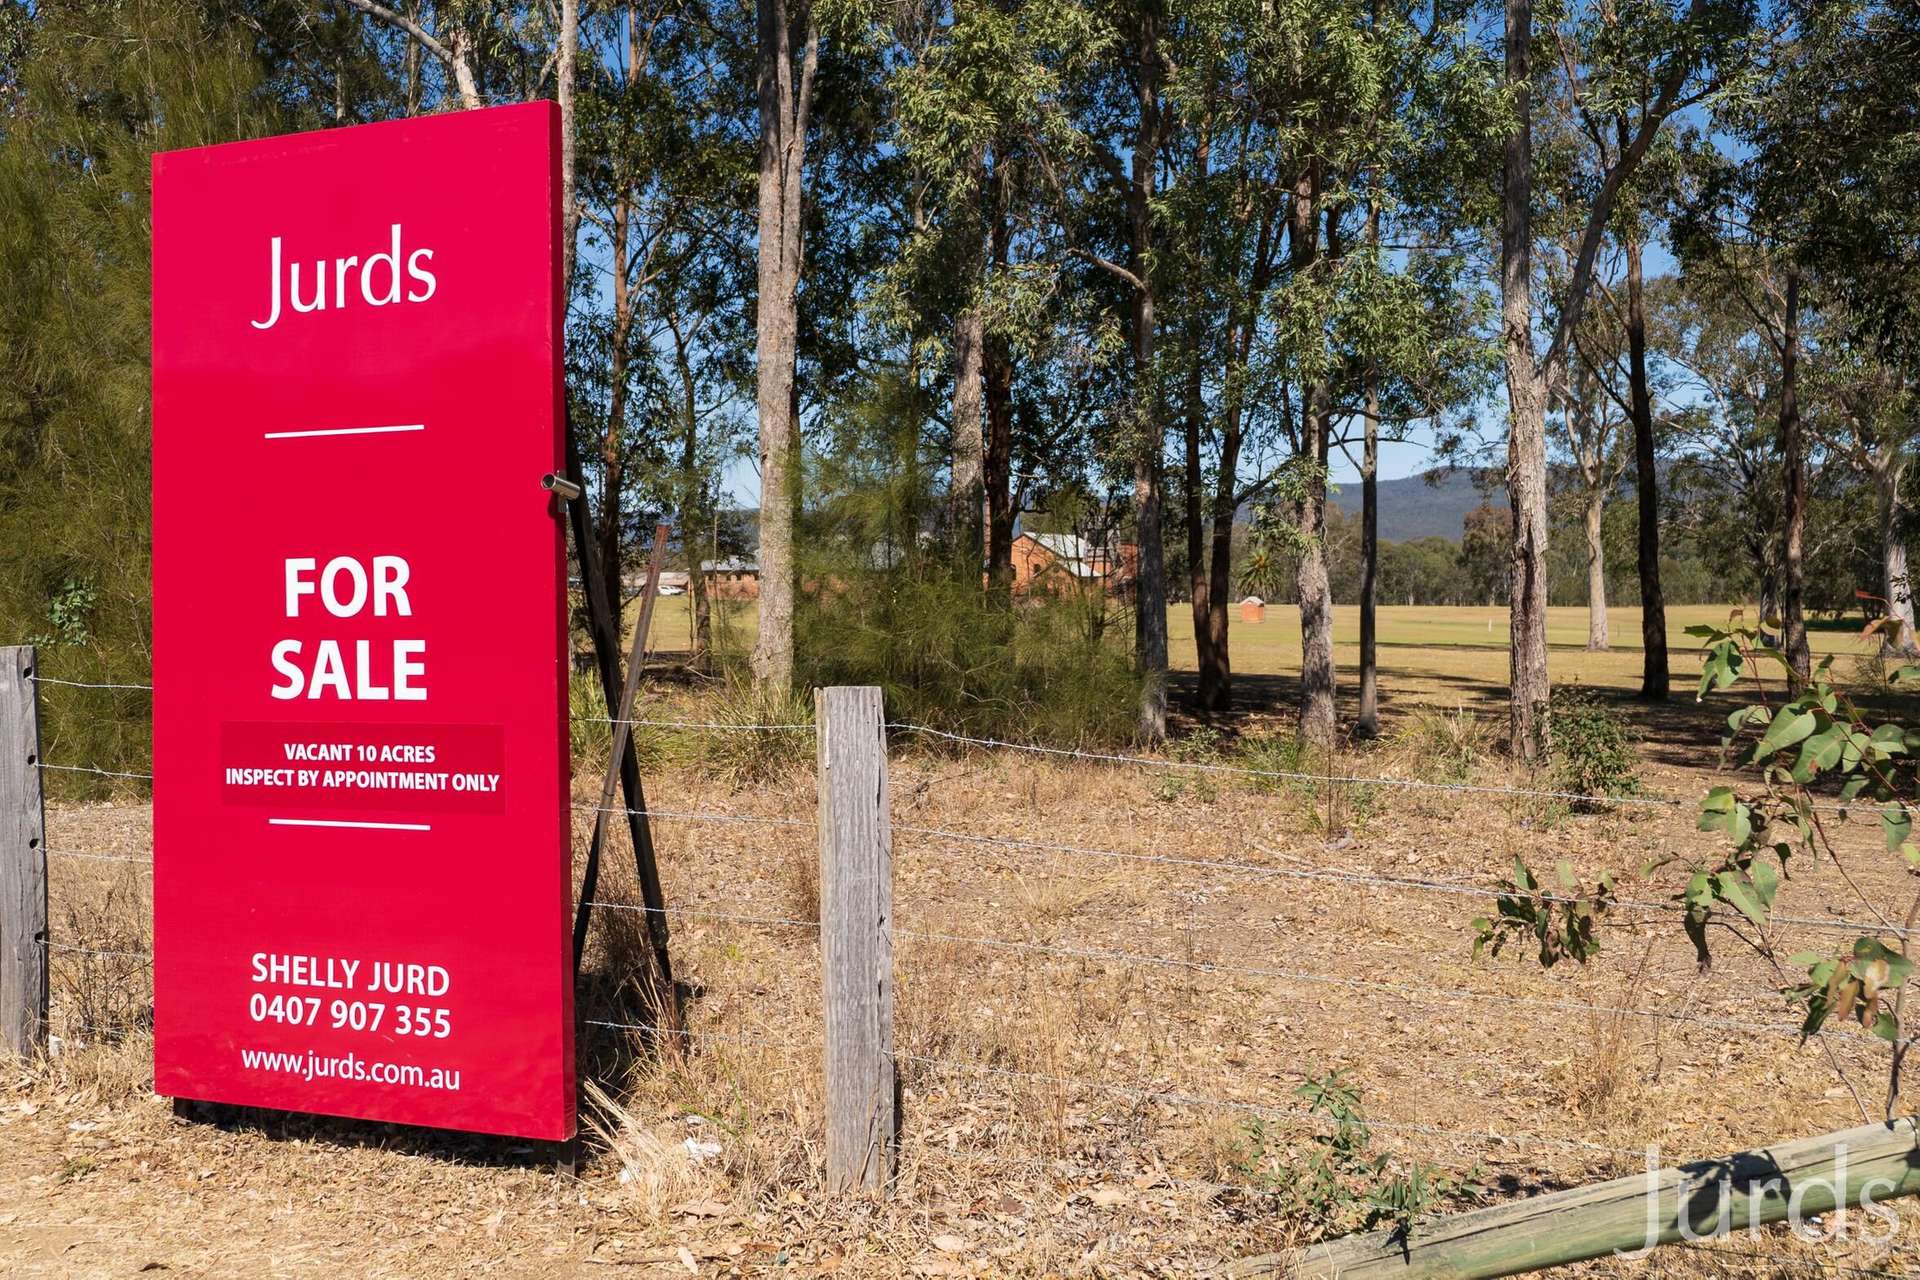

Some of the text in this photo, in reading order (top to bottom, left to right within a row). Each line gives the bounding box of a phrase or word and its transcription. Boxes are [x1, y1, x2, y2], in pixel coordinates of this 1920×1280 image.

[251, 224, 437, 329] Jurds
[285, 556, 412, 617] FOR
[271, 640, 428, 701] SALE
[284, 744, 436, 763] VACANT 10 ACRES
[226, 768, 500, 792] INSPECT BY APPOINTMENT ONLY
[252, 953, 450, 997] SHELLY JURD
[249, 993, 451, 1039] 0407 907 355
[241, 1049, 460, 1090] www.jurds.com.au
